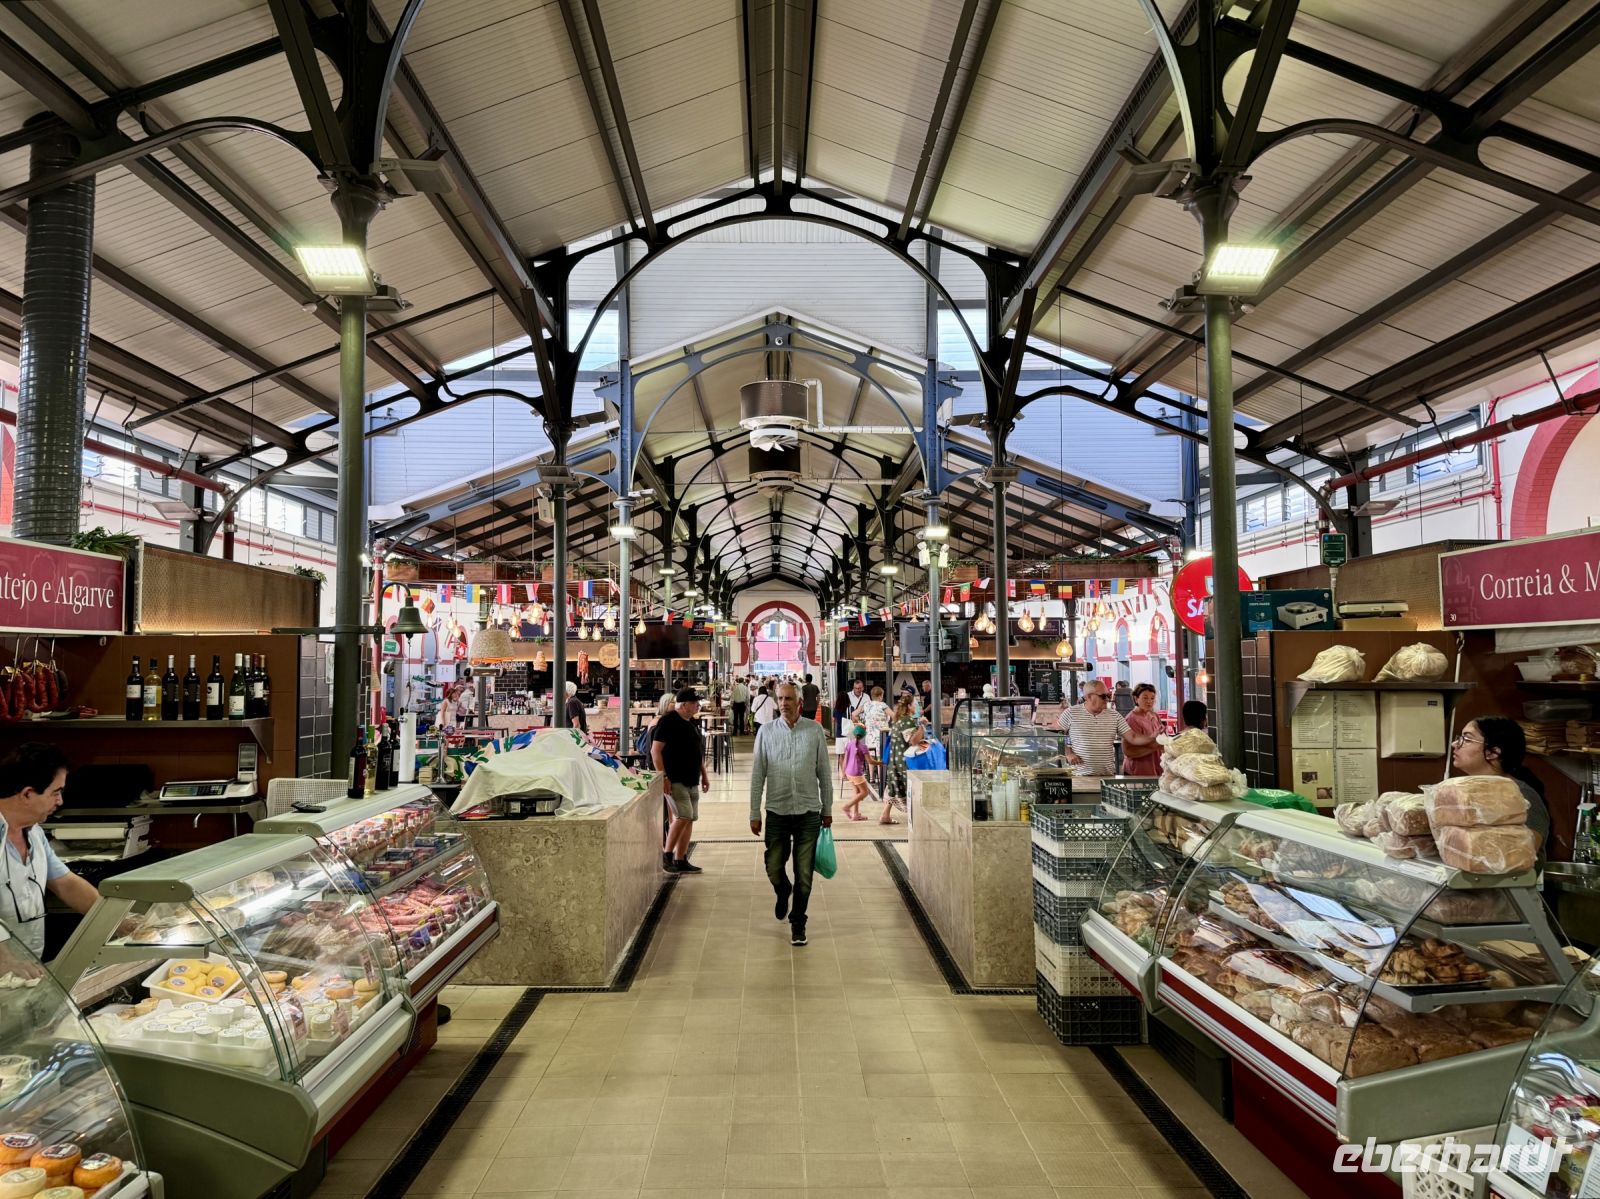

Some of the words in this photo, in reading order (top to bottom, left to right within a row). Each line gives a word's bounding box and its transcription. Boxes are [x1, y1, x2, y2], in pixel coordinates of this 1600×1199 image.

[0, 571, 38, 610] tejo
[42, 581, 52, 603] e
[54, 576, 114, 615] Algarve
[1480, 569, 1554, 601] Correia
[1559, 564, 1578, 594] &
[1449, 613, 1457, 622] 30
